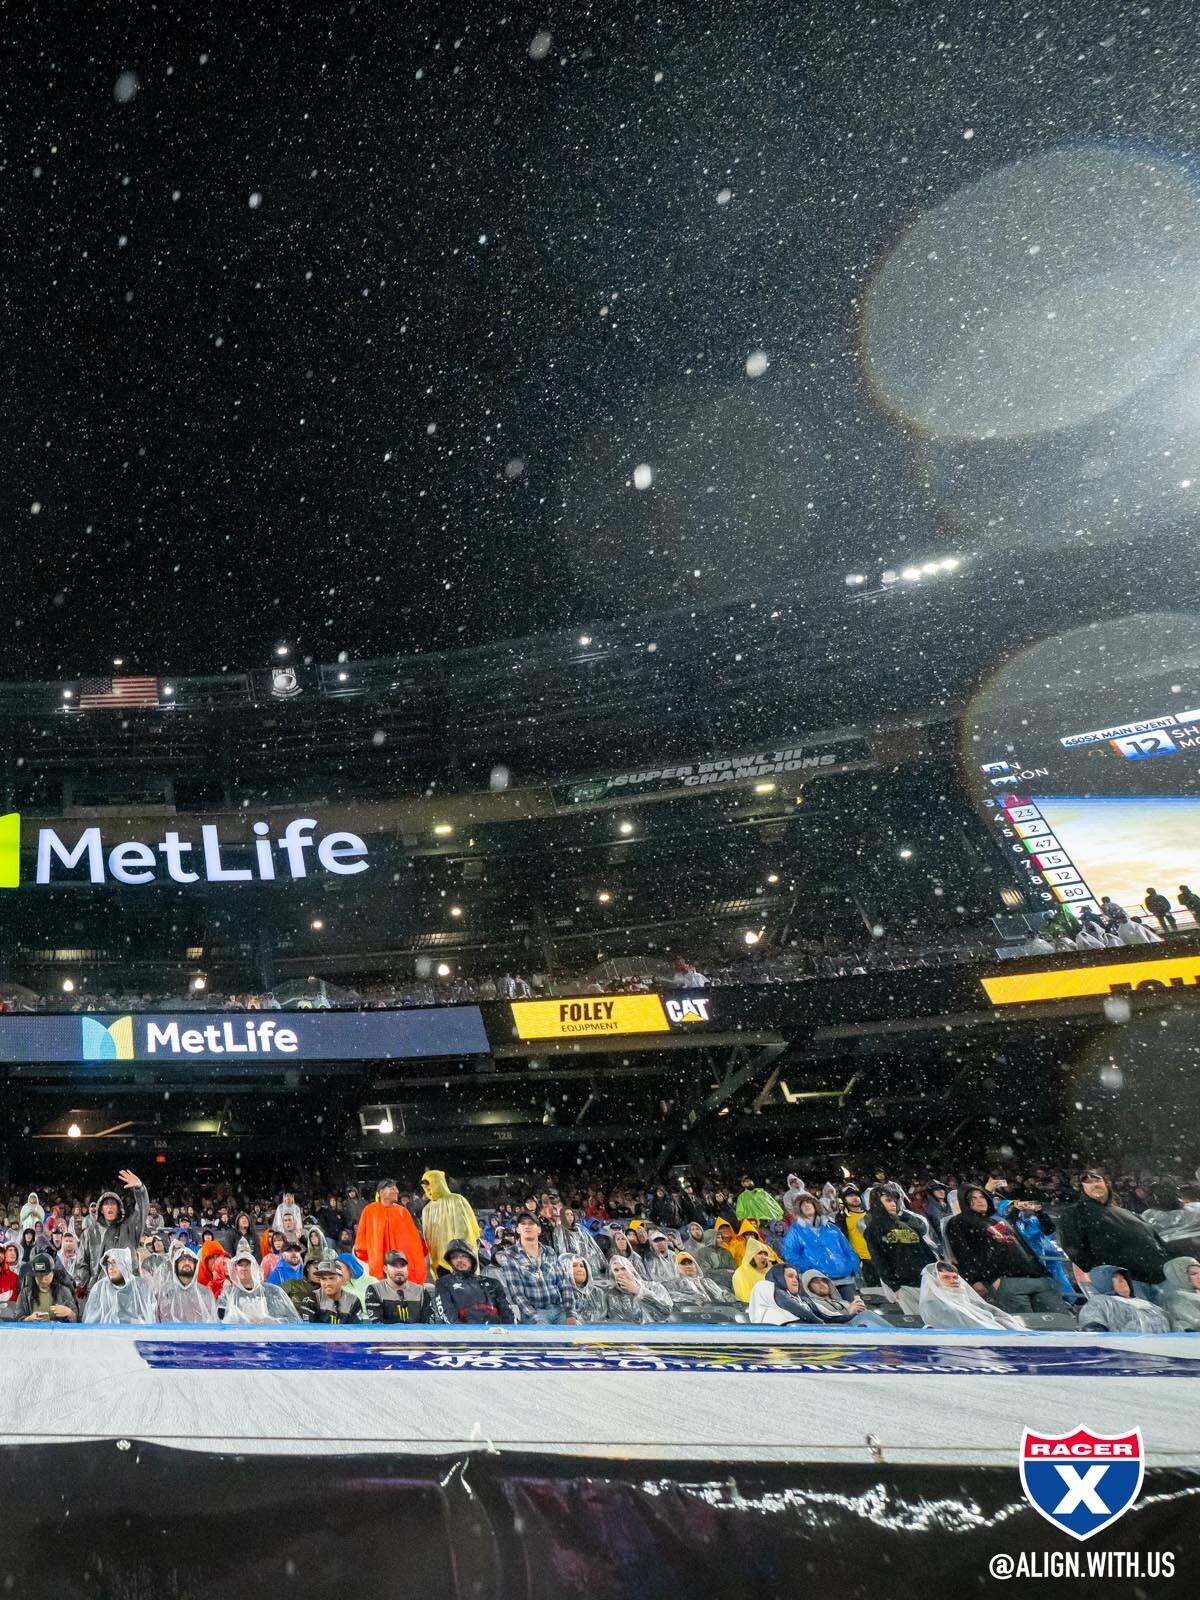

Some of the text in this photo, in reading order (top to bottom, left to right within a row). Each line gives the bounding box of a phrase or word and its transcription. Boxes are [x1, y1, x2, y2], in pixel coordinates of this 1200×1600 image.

[1064, 718, 1174, 746] 450SX MAIN EVENT
[1126, 737, 1169, 756] 12
[613, 766, 694, 786] SUPER
[698, 754, 769, 774] BOWL
[683, 754, 837, 787] CHAMPIONS
[993, 809, 1034, 822] 4 23
[1002, 824, 1040, 838] 5 2
[35, 818, 371, 885] MetLife
[1012, 839, 1052, 853] 6 47
[1020, 855, 1062, 869] 7 15
[1031, 871, 1073, 885] 8 12
[1040, 887, 1084, 901] 9 80
[559, 1001, 615, 1022] FOLEY
[666, 998, 710, 1022] CAT
[147, 1020, 299, 1053] MetLife
[560, 1021, 620, 1033] EQUIPMENT
